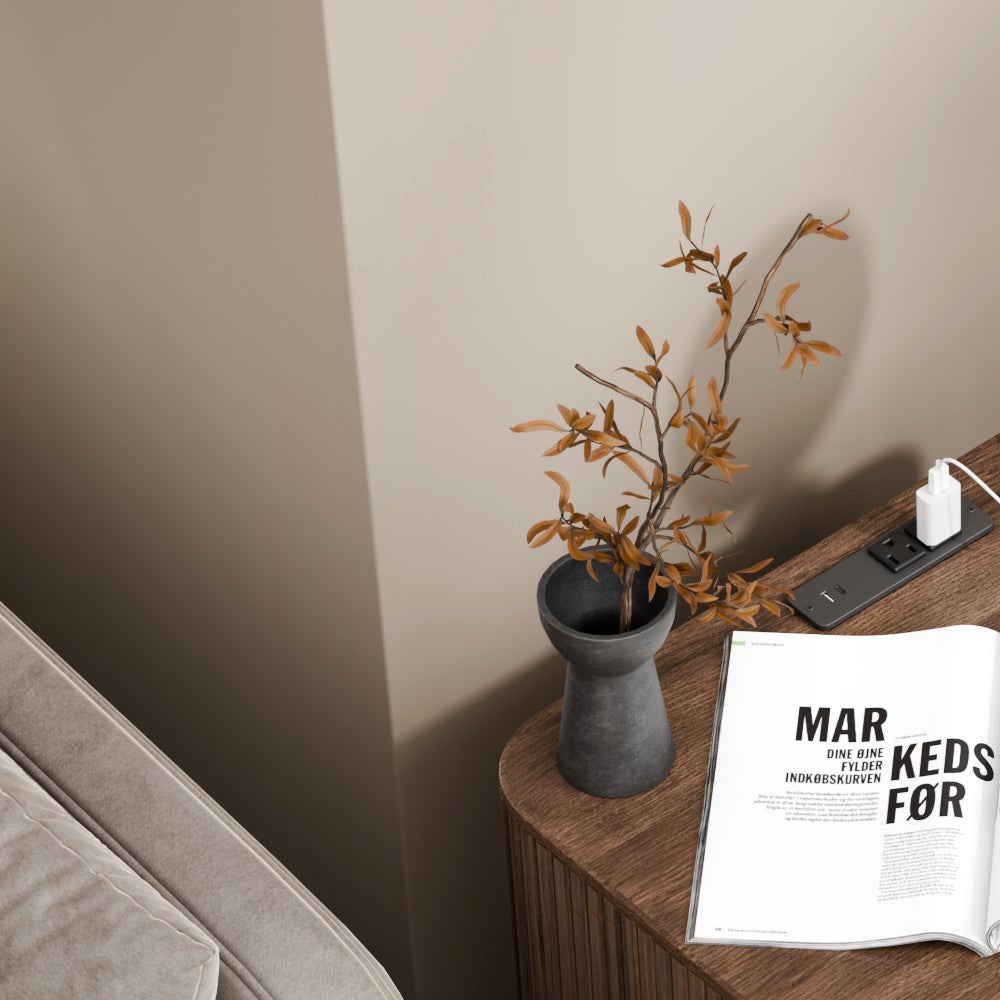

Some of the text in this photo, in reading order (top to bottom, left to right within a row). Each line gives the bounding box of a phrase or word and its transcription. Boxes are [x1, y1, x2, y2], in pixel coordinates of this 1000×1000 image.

[795, 706, 887, 743] MAR
[826, 747, 884, 759] DINE ØJNE
[891, 738, 995, 781] KEDS
[785, 772, 881, 785] INDKØBSKURVEN
[841, 760, 883, 772] FYLDER
[886, 781, 966, 824] FØR
